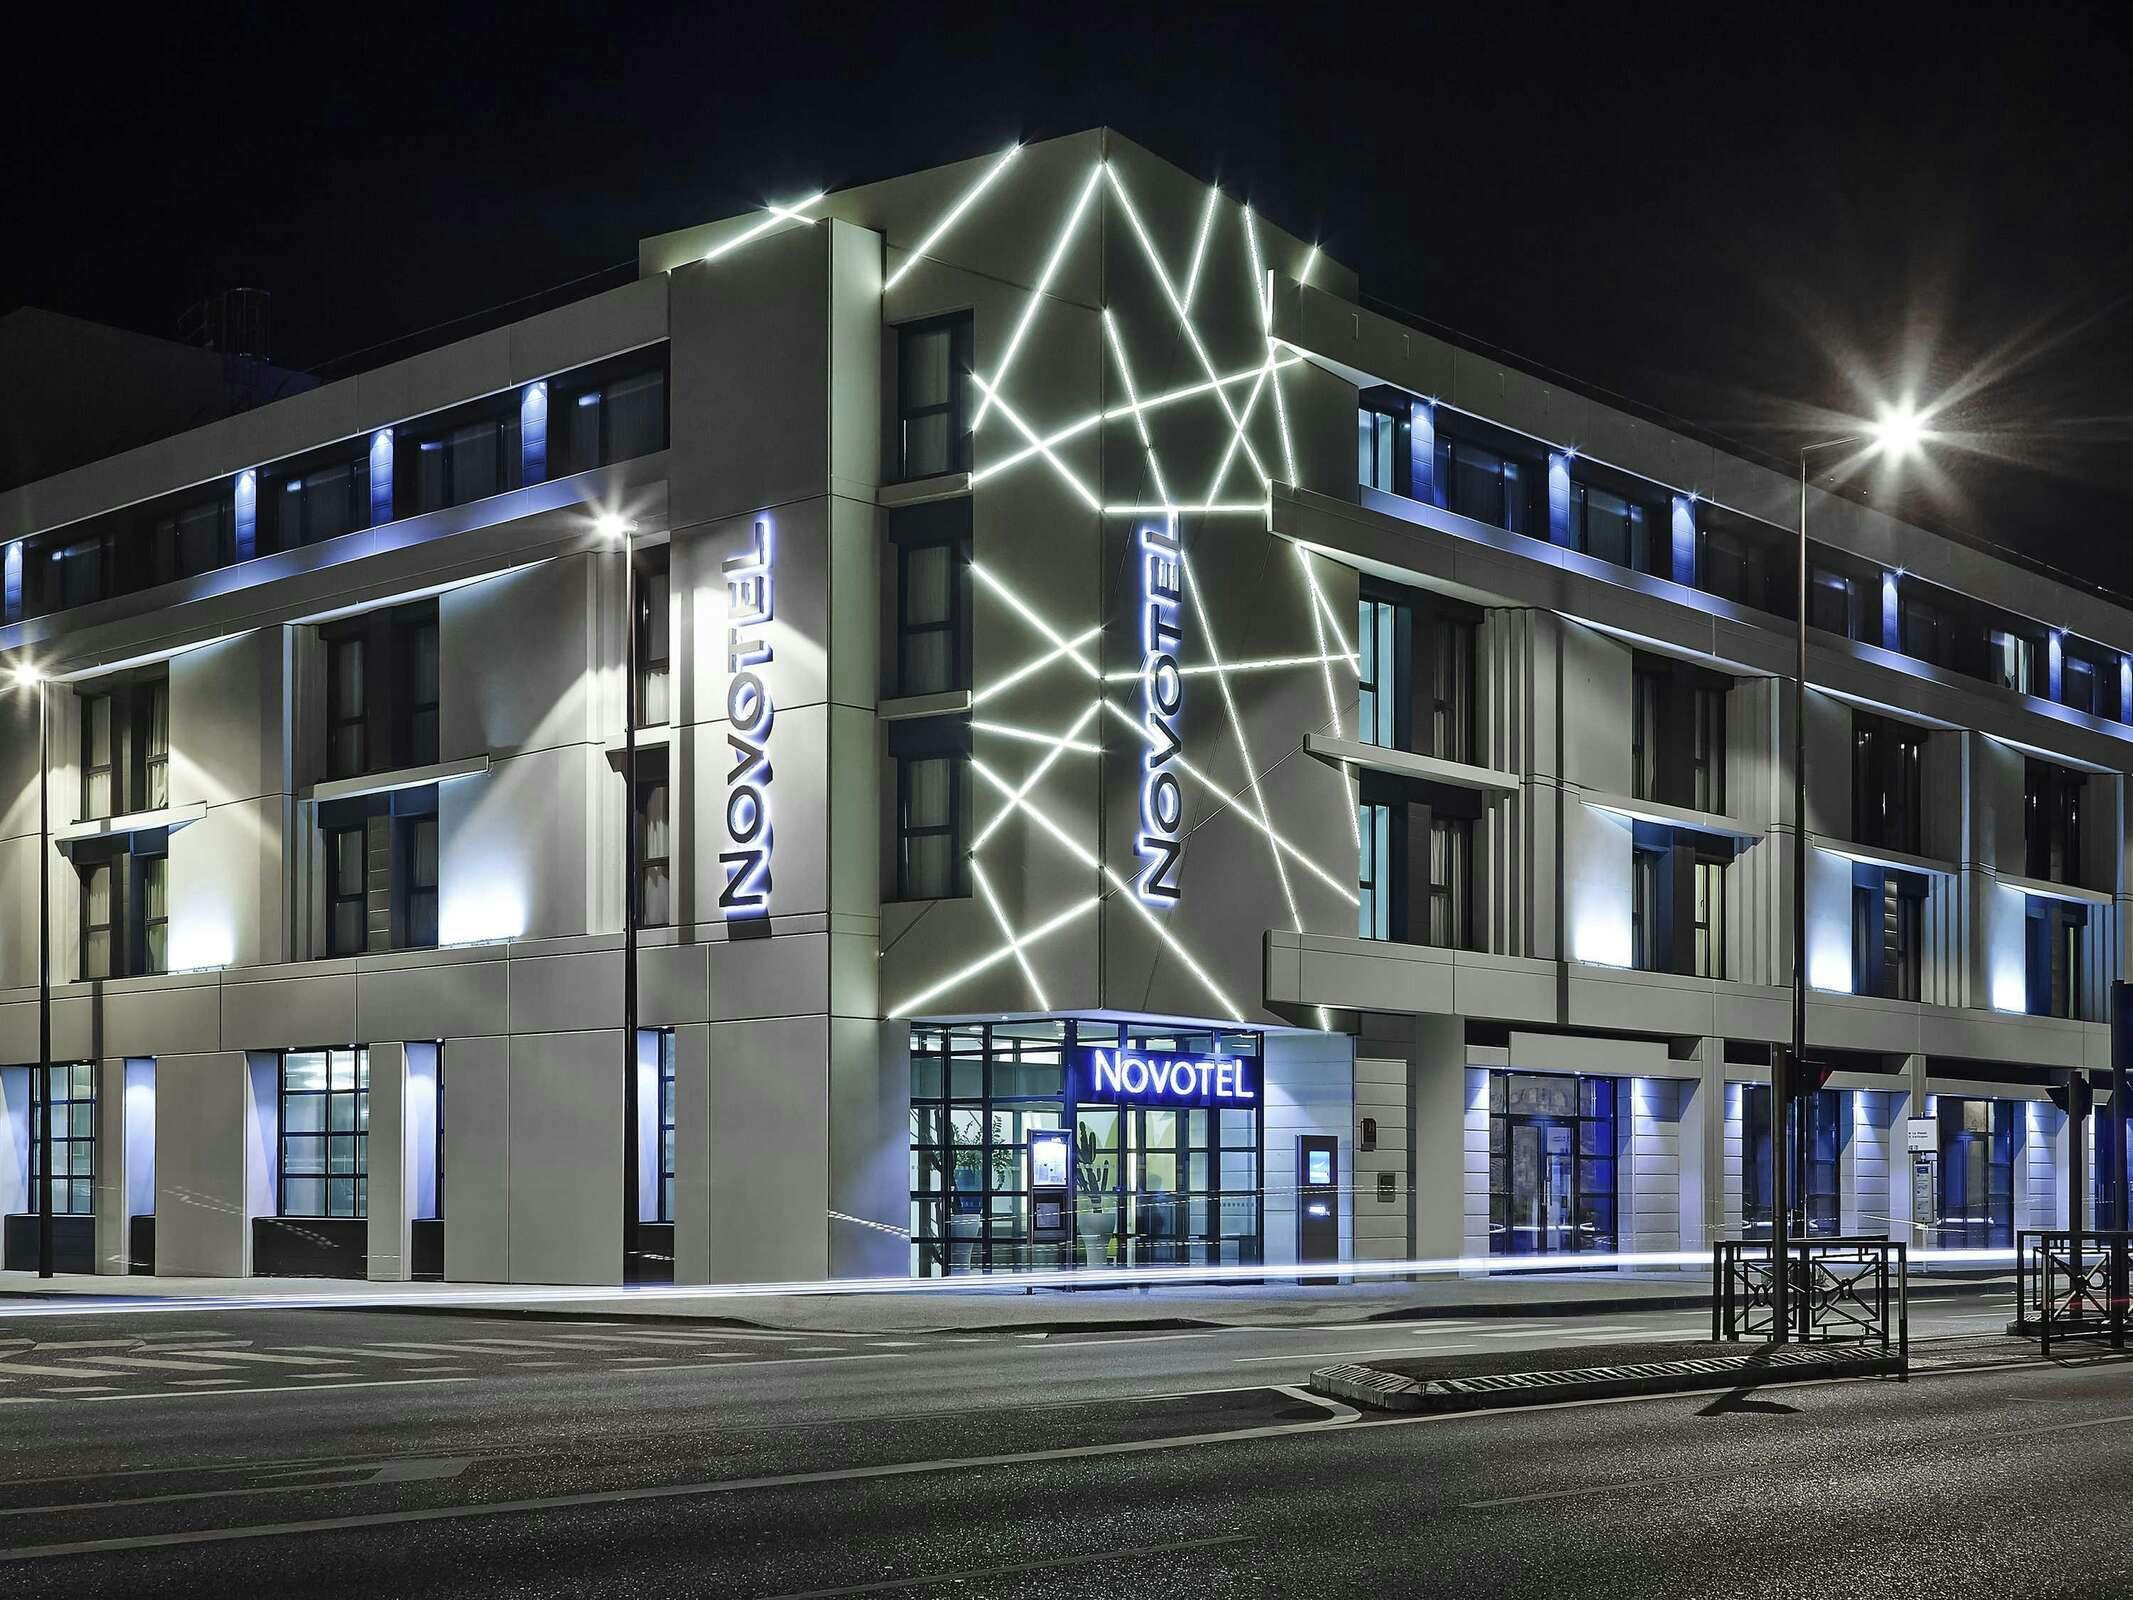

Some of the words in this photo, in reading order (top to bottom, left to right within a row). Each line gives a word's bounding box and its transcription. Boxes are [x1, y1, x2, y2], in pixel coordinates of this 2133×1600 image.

[719, 521, 769, 908] NOVOTEL
[1141, 510, 1183, 901] NOVOTEL
[1094, 1049, 1255, 1098] NOVOTEL
